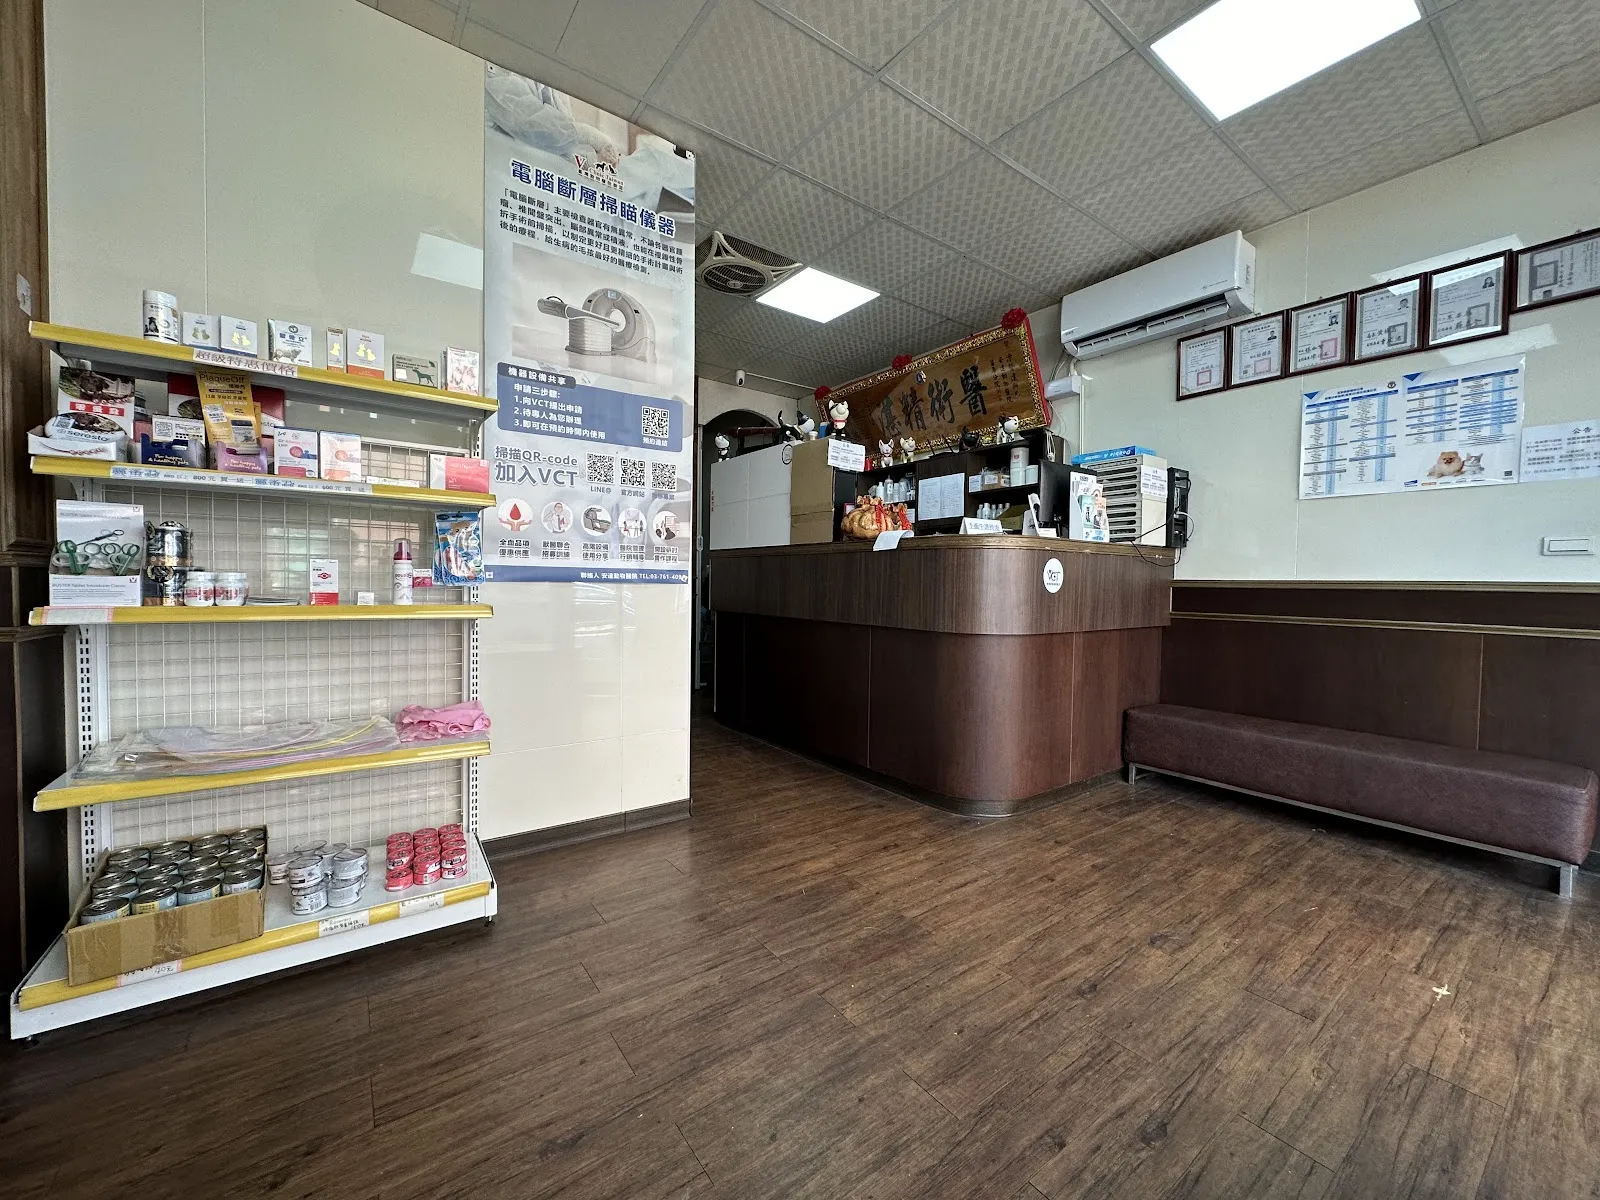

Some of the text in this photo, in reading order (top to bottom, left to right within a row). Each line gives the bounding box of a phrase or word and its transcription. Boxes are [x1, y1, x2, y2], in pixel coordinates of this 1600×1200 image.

[511, 159, 675, 237] 電腦斷層掃瞄儀器
[508, 366, 566, 385] 機器設備共享
[514, 382, 560, 399] 申請三步驟:
[514, 395, 582, 414] 1.向VCT提出申請
[514, 407, 582, 425] 2.待專人為您辦理
[514, 419, 605, 439] 3.即可在預約時間內使用
[496, 445, 577, 466] 掃描QR-code
[496, 461, 577, 487] 加入VCT
